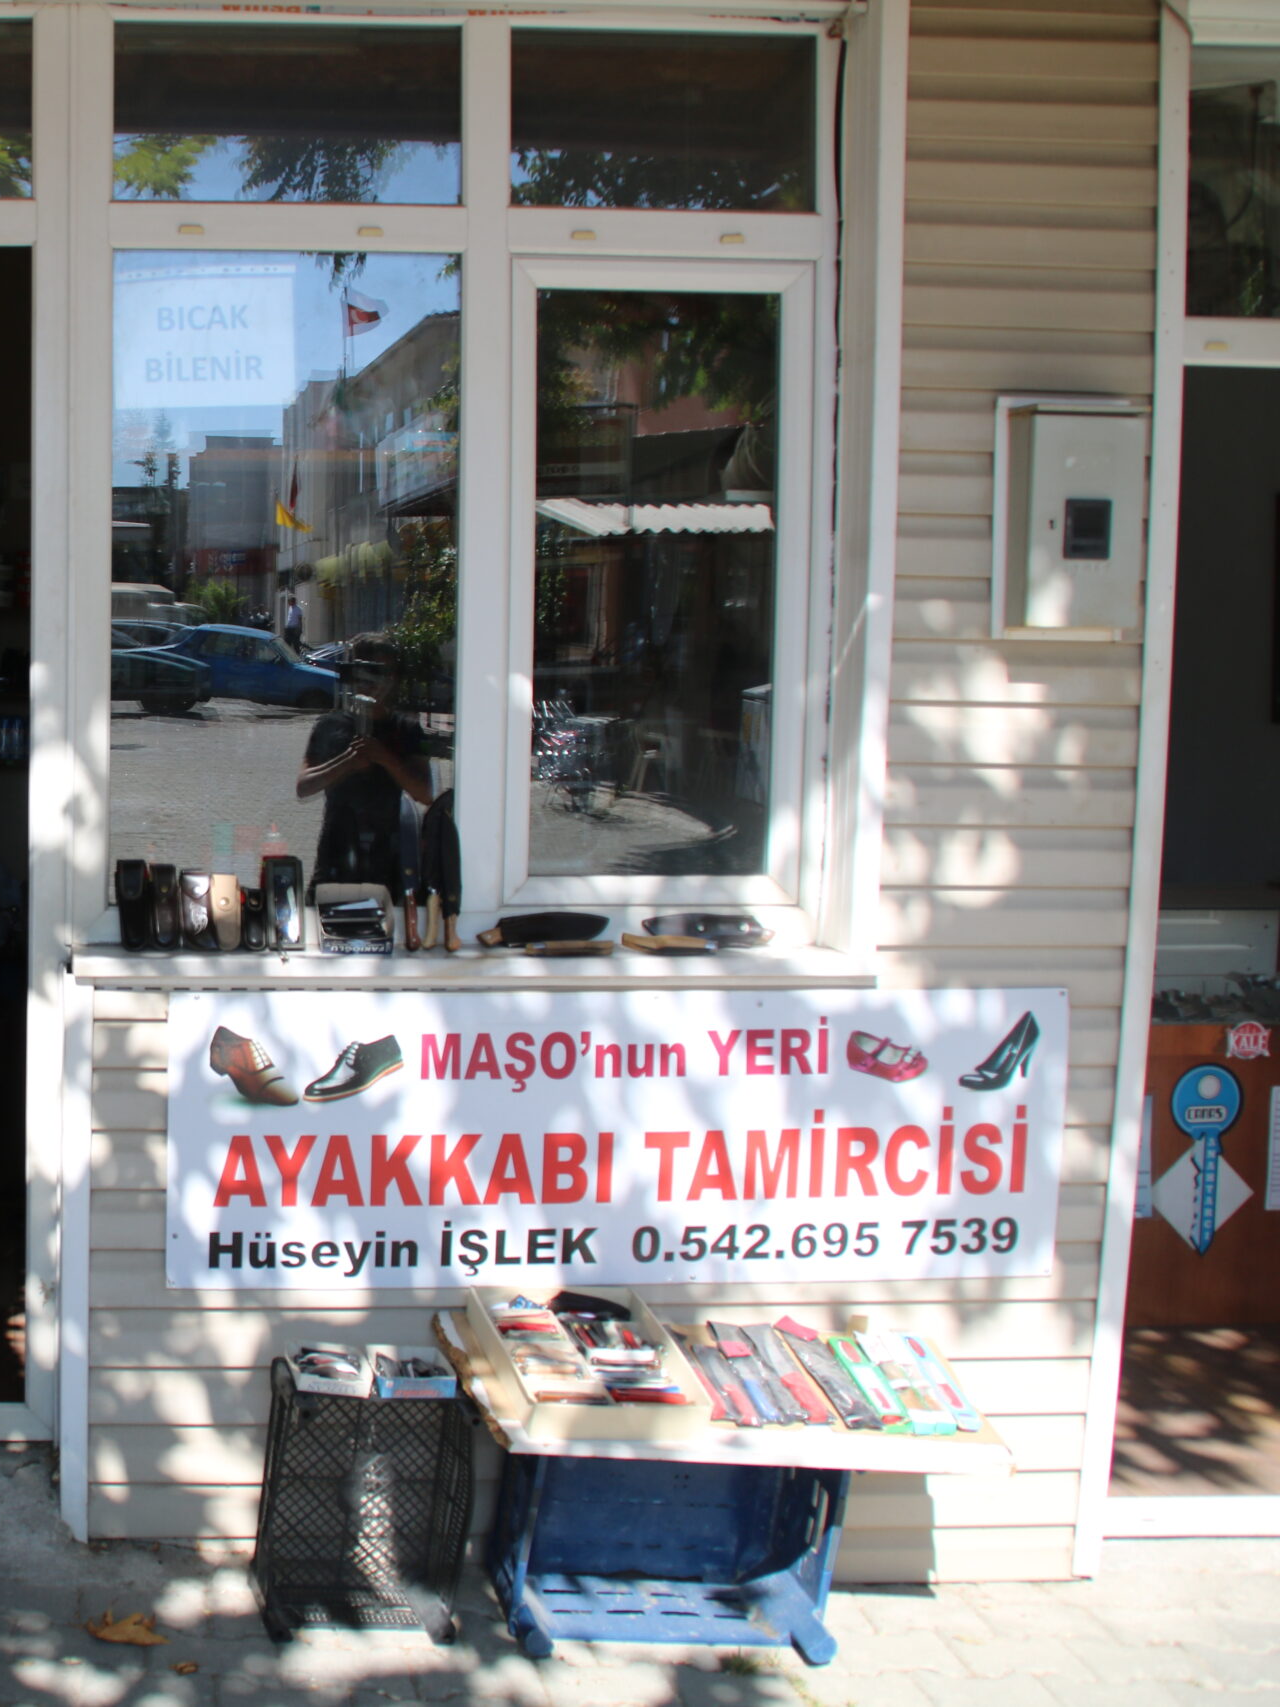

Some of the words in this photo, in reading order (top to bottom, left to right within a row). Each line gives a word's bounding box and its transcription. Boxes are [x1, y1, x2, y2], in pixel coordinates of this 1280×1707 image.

[145, 350, 264, 383] BİLENİR
[707, 1016, 829, 1077] YERİ
[1227, 1030, 1269, 1054] KALE
[213, 1131, 615, 1208] AYAKKABI
[644, 1105, 1029, 1203] TAMİRCİSİ
[208, 1230, 419, 1278] Hüseyin
[440, 1220, 599, 1276] İŞLEK
[631, 1221, 881, 1263] 0.542.695
[901, 1216, 1020, 1257] 7539
